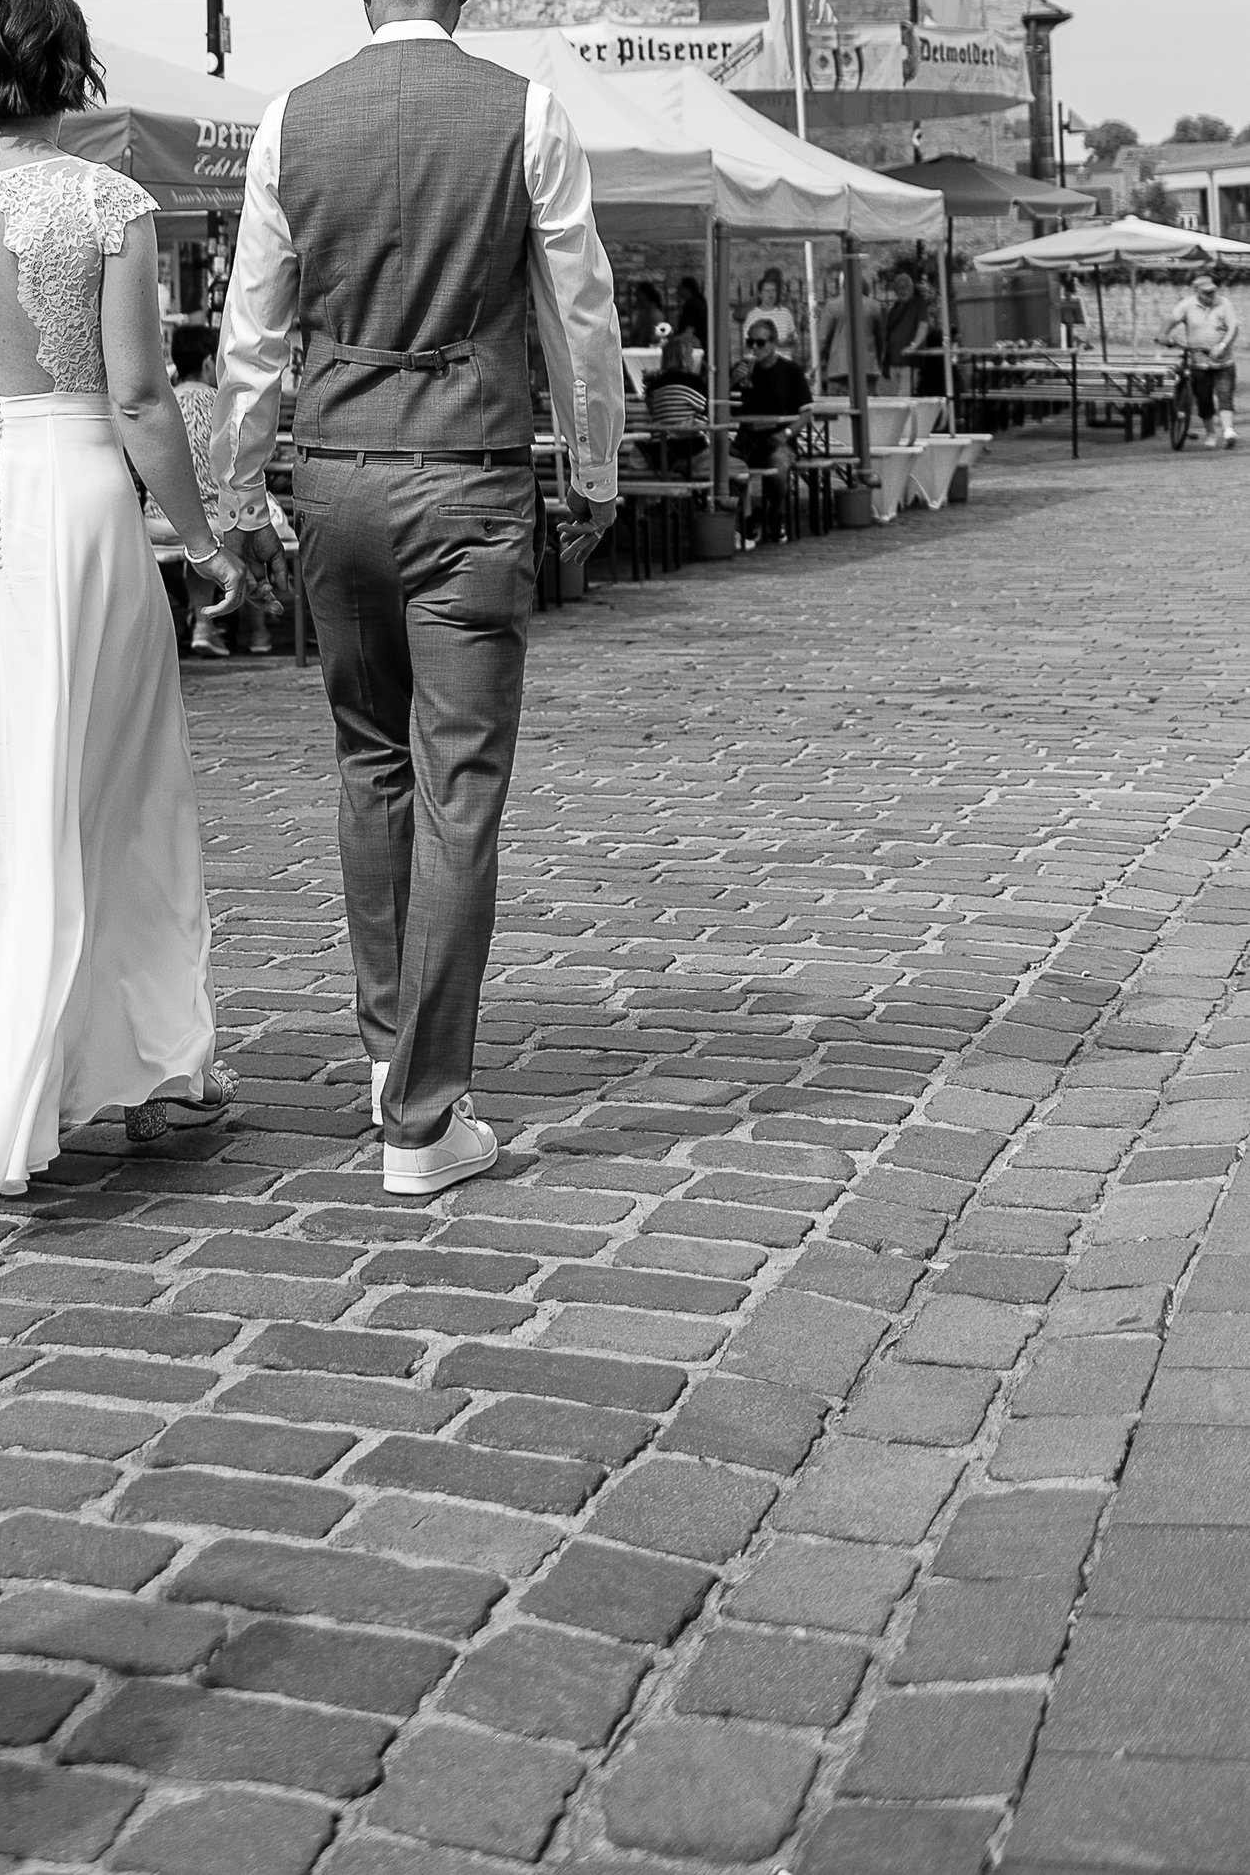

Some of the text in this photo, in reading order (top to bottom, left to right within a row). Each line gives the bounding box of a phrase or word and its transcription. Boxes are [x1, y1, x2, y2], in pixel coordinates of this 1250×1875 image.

[616, 35, 732, 67] Pilsener
[919, 36, 995, 65] Detmolder
[193, 152, 231, 177] Echt
